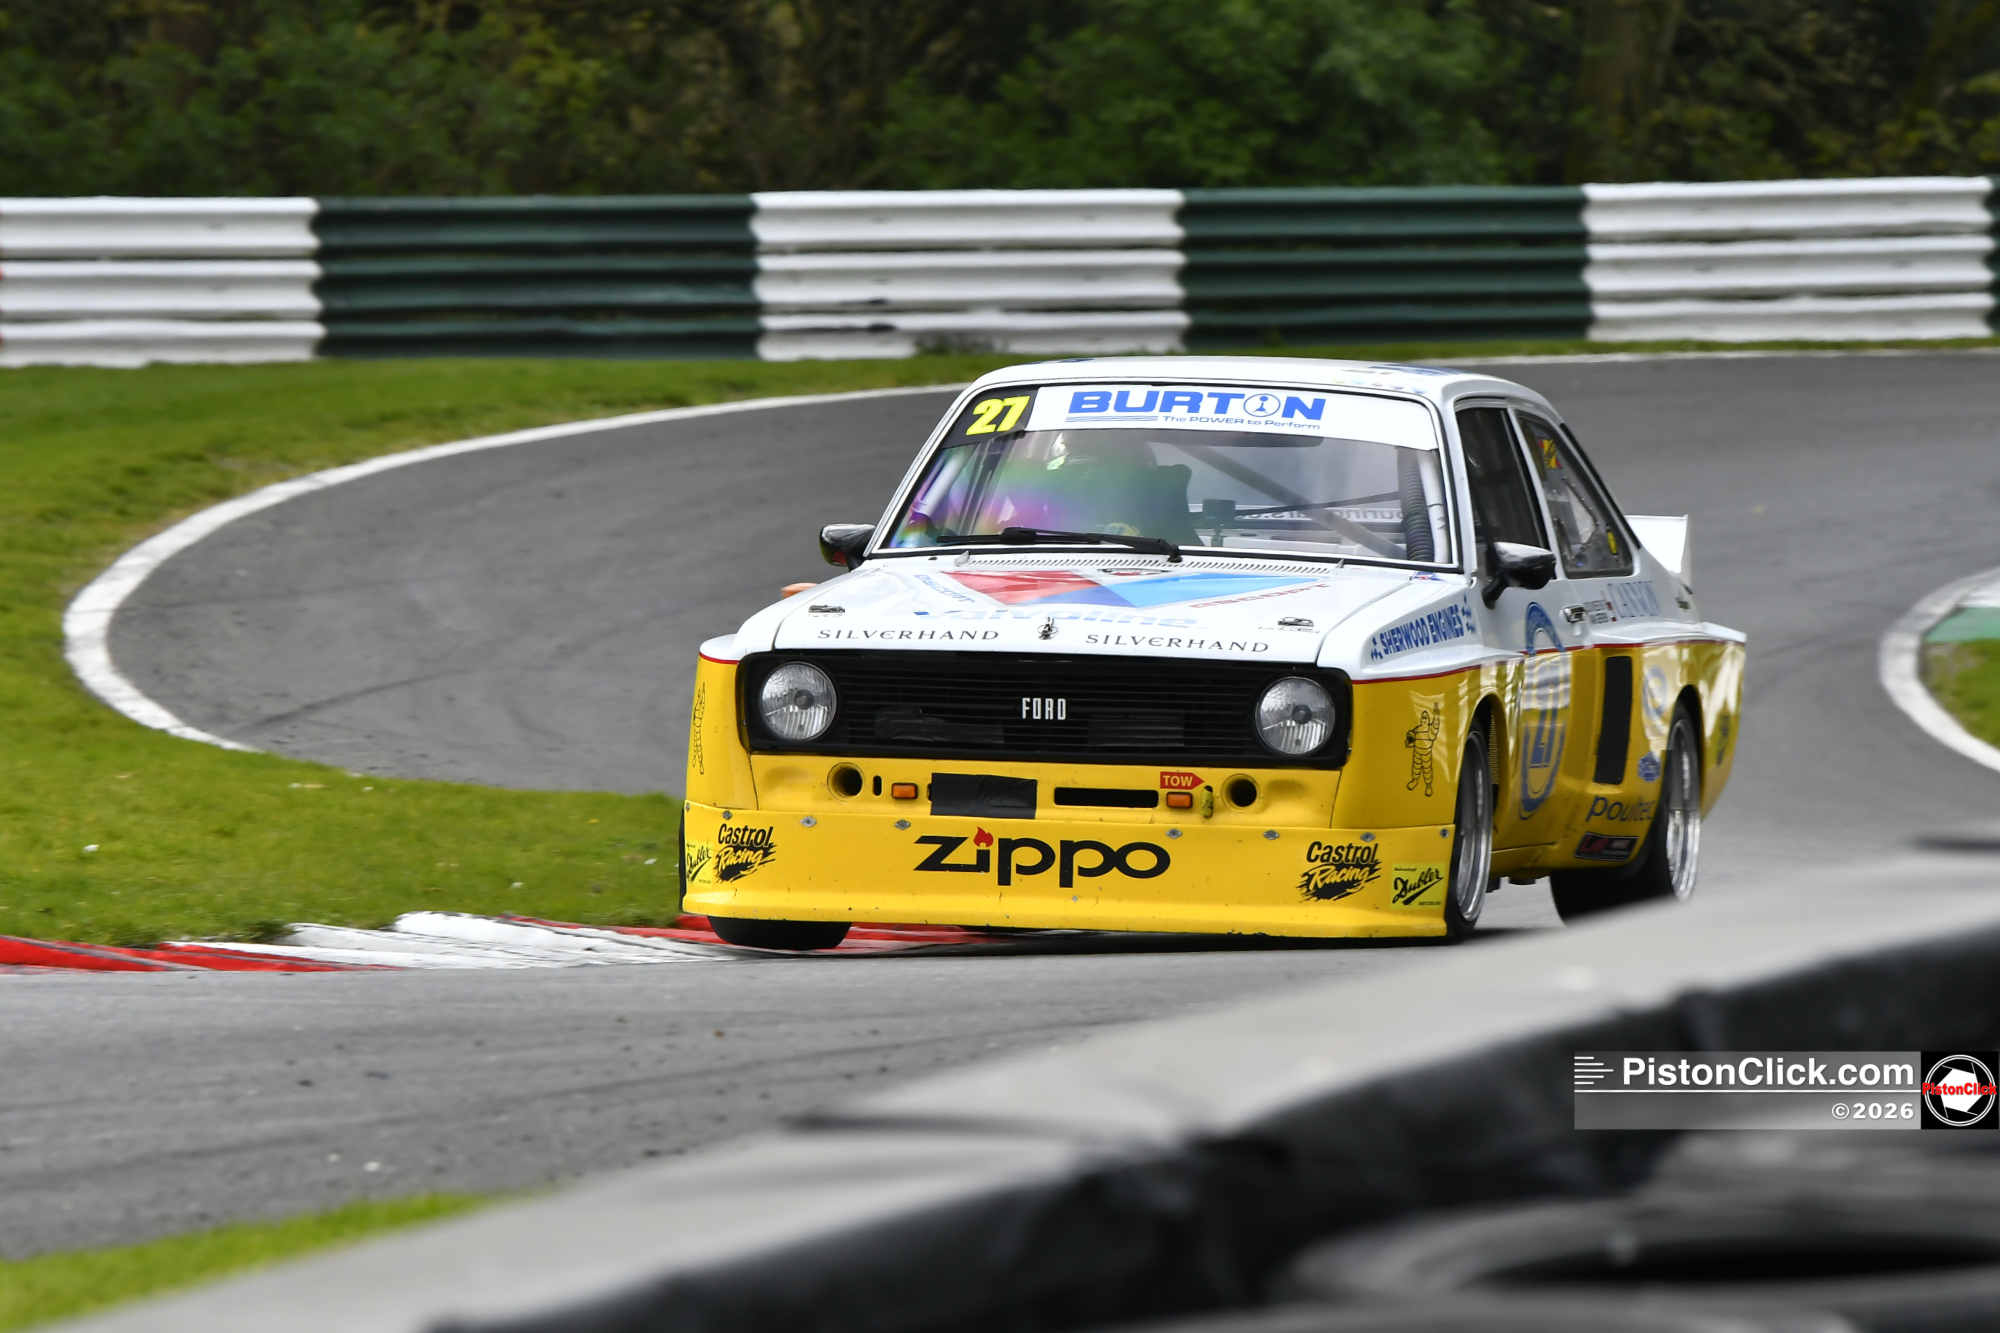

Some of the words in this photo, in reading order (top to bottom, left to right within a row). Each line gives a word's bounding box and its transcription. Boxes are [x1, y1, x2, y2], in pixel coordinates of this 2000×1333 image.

[966, 396, 1030, 436] 27
[1068, 390, 1326, 421] BURTON
[1189, 416, 1244, 424] POWER
[1264, 419, 1321, 430] Perform
[817, 629, 999, 641] SILVERHAND
[1379, 617, 1430, 656] SHERWOOD
[1426, 604, 1465, 644] ENGINES
[1085, 634, 1270, 653] SILVERHAND
[1021, 698, 1067, 720] FORD
[1162, 775, 1194, 787] TOW
[718, 823, 774, 848] Castrol
[717, 846, 765, 875] Racing
[1306, 841, 1379, 865] Castrol
[1308, 864, 1371, 893] Racing
